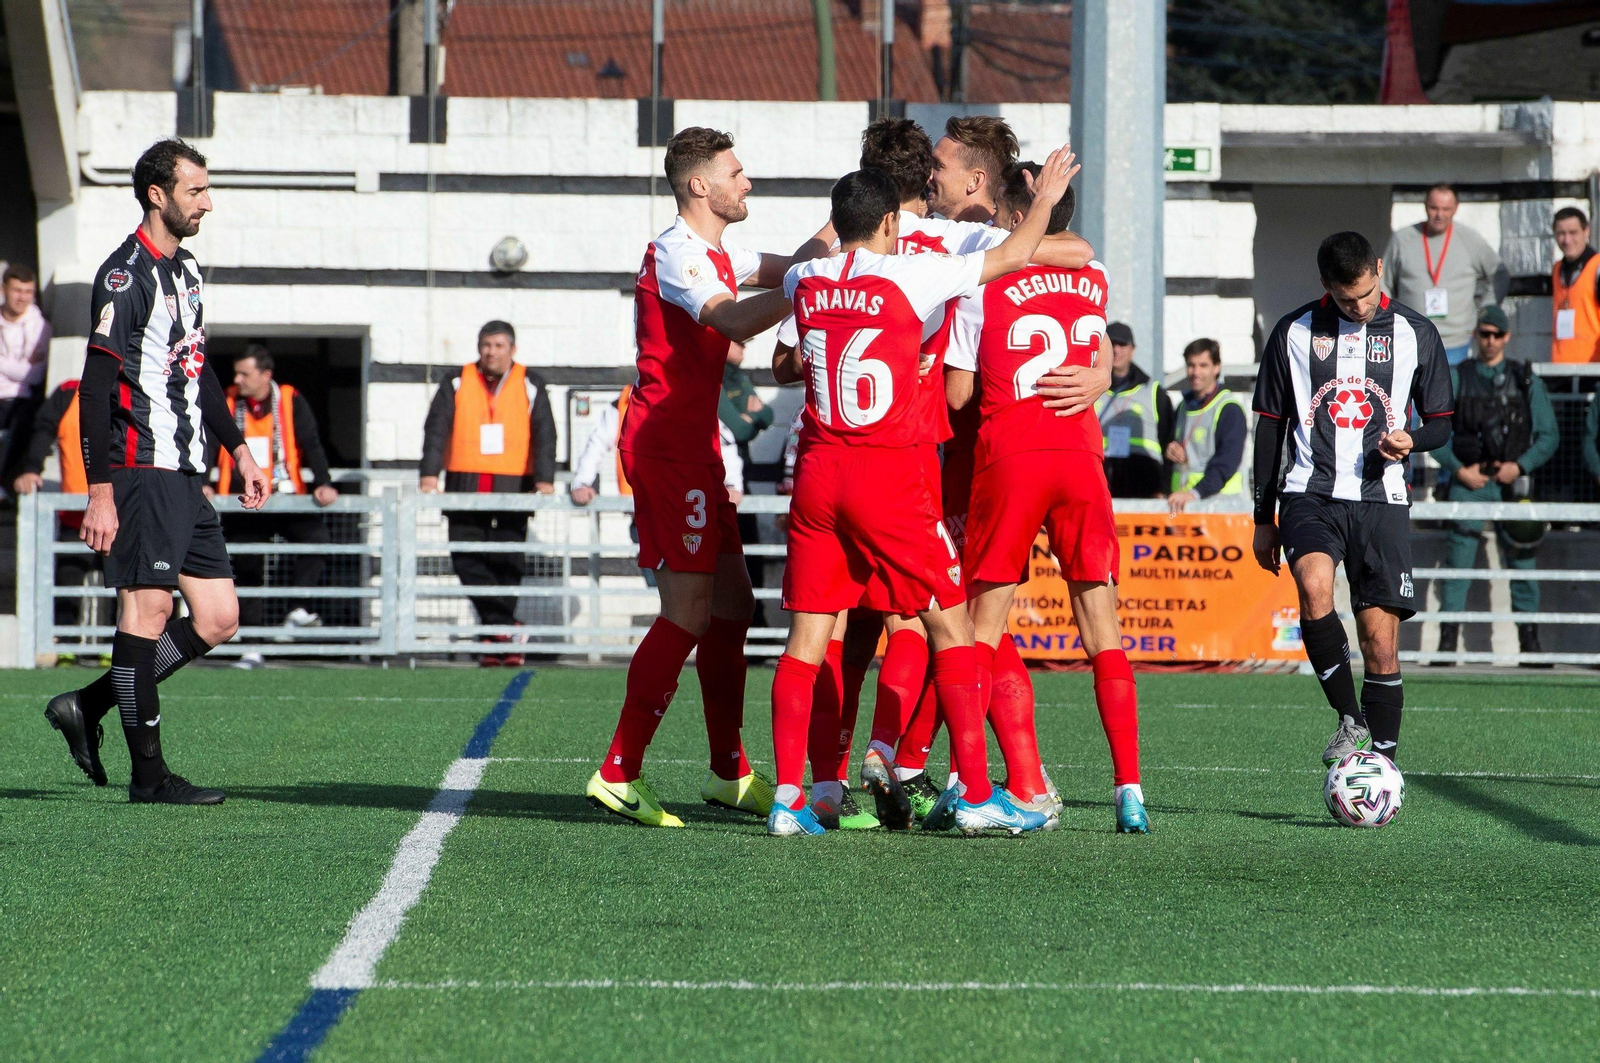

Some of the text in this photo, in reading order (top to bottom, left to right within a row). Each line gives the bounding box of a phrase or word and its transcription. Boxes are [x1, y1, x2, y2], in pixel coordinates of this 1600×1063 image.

[1004, 273, 1103, 306] REGUILON
[802, 328, 894, 428] 16
[1304, 375, 1396, 428] Desguaces de Escobedo
[685, 489, 707, 529] 3
[1115, 525, 1205, 538] ERES
[1133, 545, 1243, 562] PARDO
